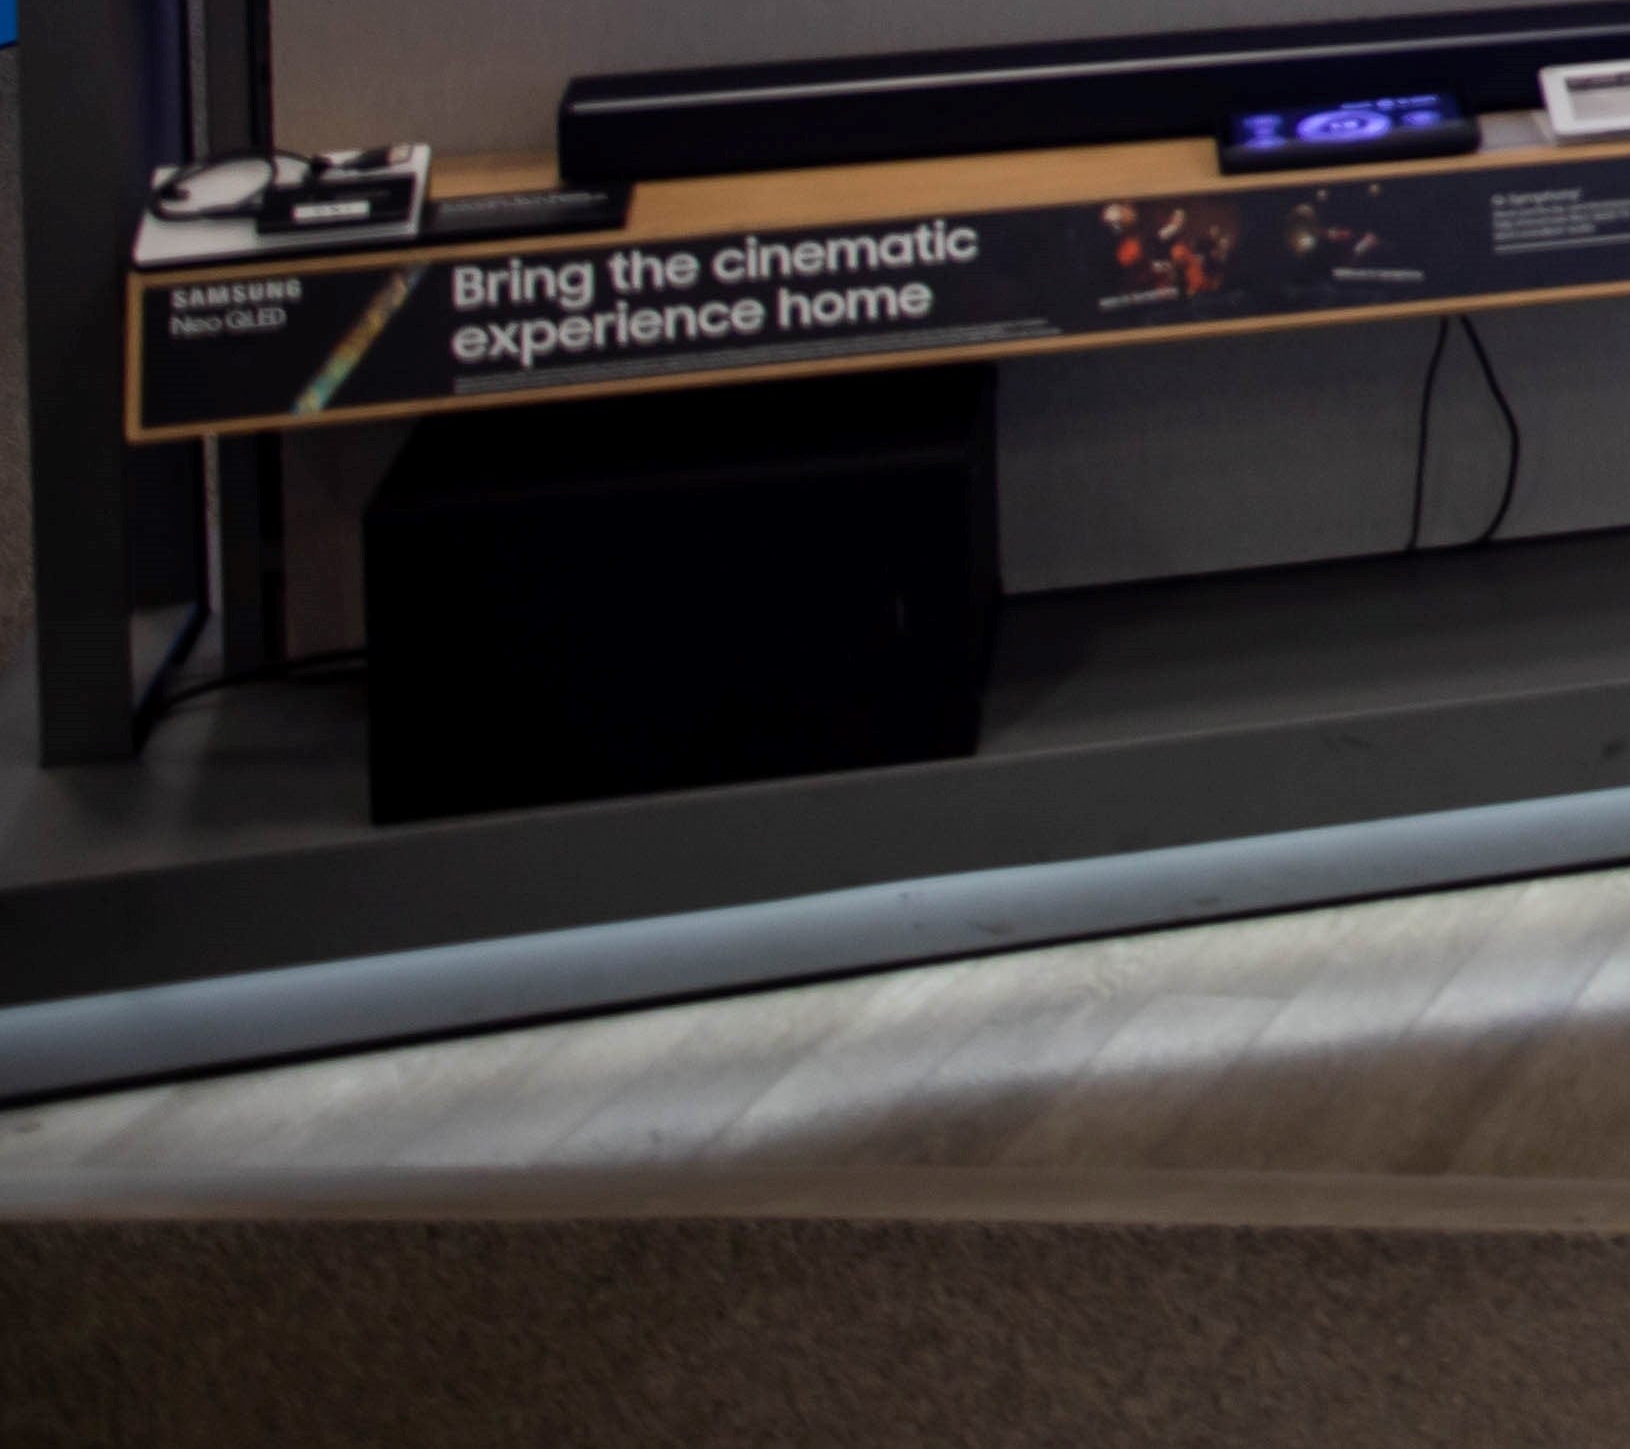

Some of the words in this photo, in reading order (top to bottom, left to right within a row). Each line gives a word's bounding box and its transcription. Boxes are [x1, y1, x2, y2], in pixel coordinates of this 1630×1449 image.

[452, 258, 594, 309] Bring
[608, 250, 699, 291] the
[712, 218, 978, 282] cinematic
[171, 312, 222, 338] Neo
[225, 305, 287, 334] QLED
[172, 279, 302, 310] SAMSUNG
[451, 296, 764, 365] experience
[779, 280, 933, 329] home
